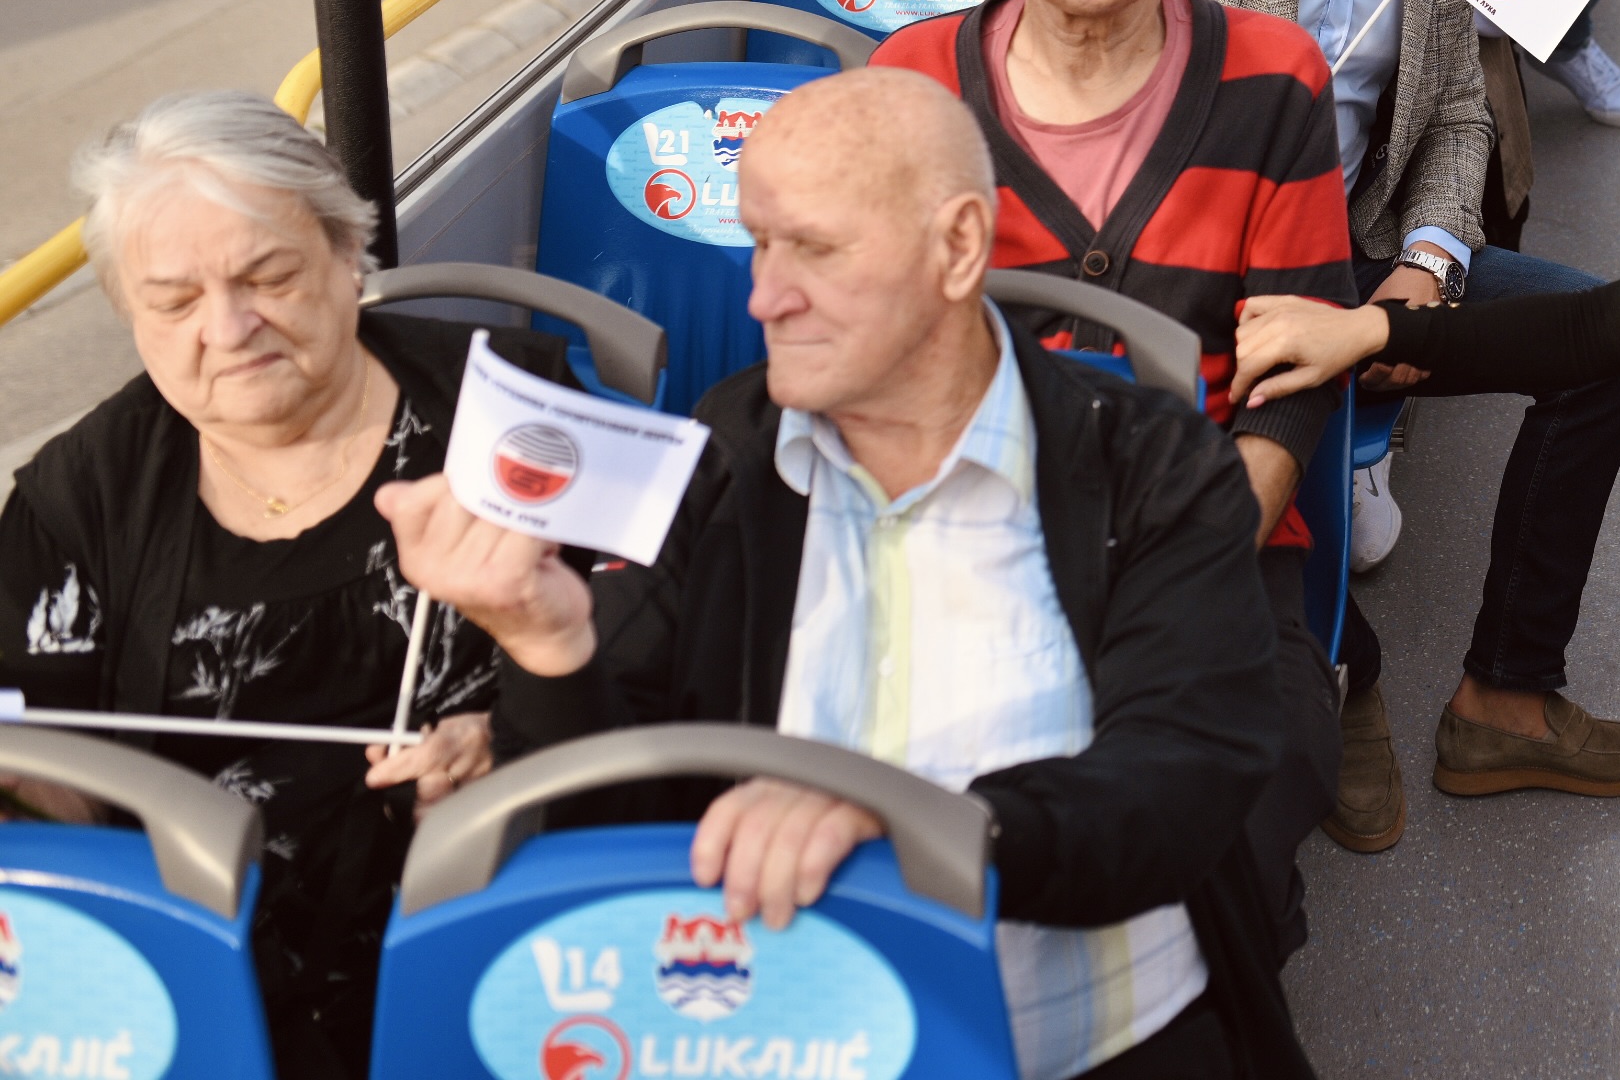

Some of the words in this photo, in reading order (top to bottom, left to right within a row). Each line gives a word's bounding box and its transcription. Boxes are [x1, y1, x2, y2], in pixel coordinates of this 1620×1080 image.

[1480, 0, 1497, 16] ЛУКА
[659, 130, 690, 153] 21
[567, 947, 622, 991] 14
[639, 1030, 870, 1080] LUKAJIĆ
